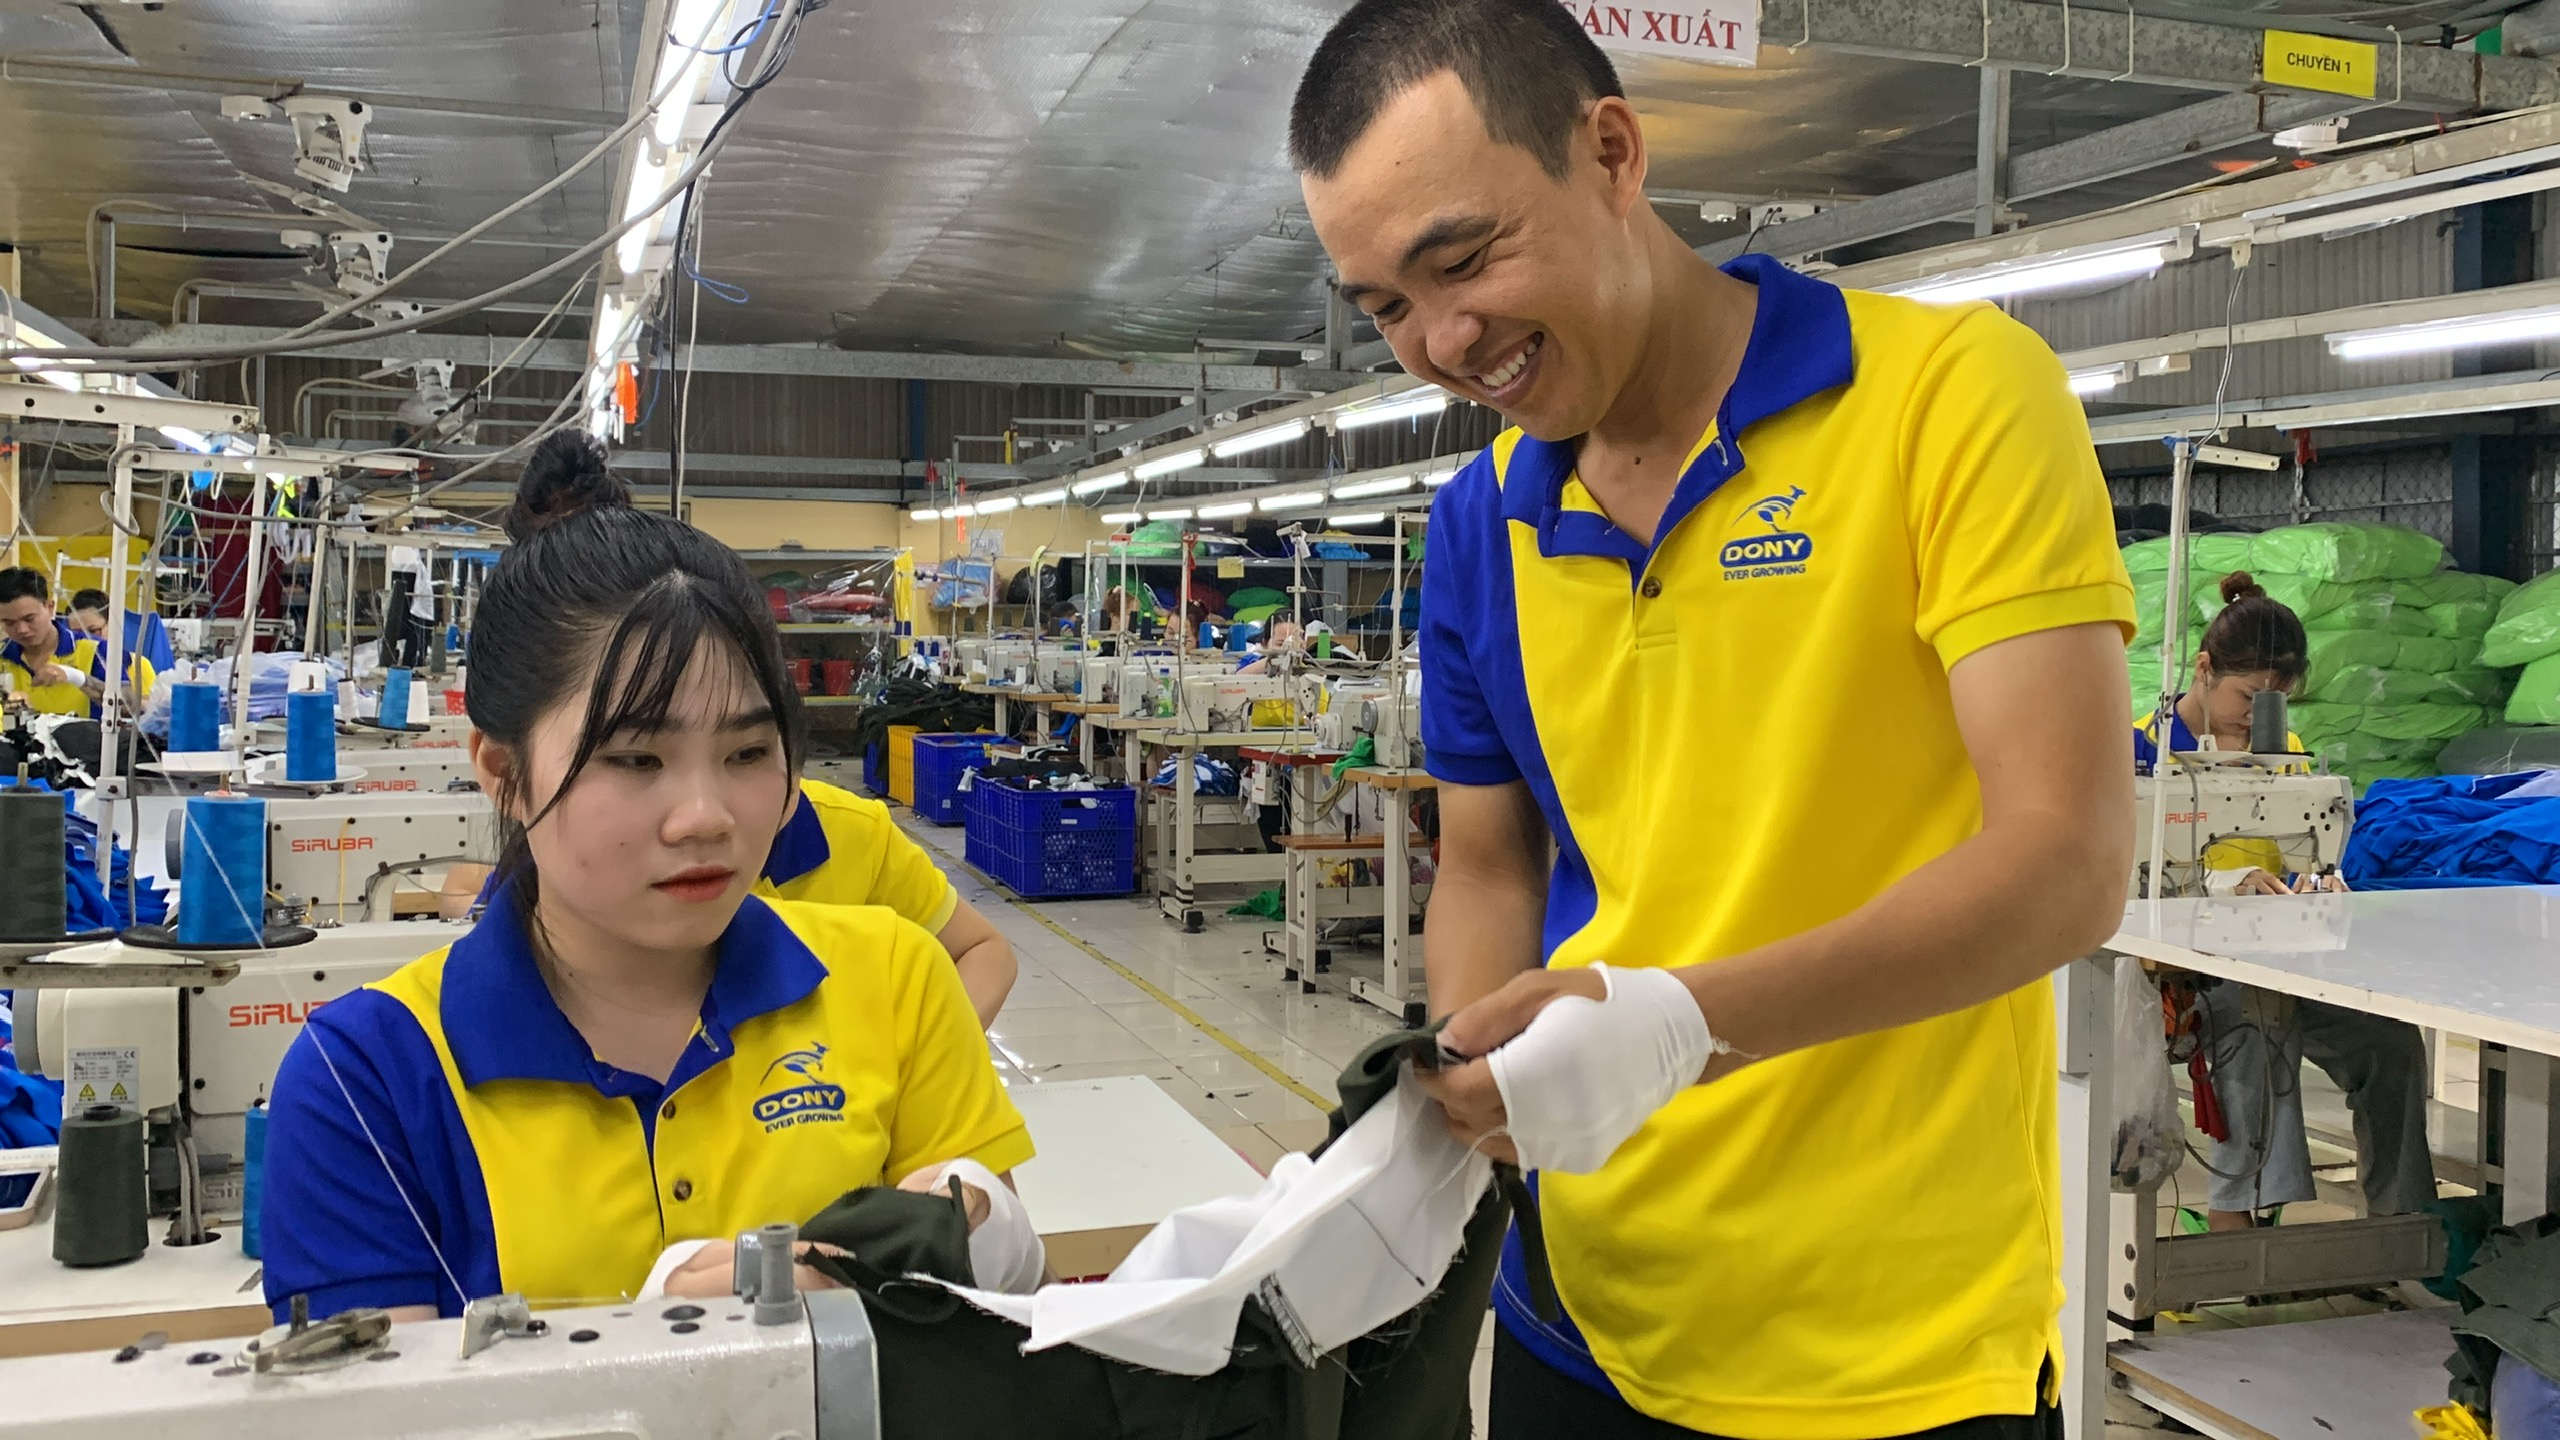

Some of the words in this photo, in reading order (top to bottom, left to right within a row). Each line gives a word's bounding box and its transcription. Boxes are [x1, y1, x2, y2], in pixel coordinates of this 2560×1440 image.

[1641, 9, 1742, 50] XUẤT
[2344, 61, 2351, 74] 1
[1724, 538, 1805, 562] DONY
[1724, 570, 1749, 580] EVER
[1751, 564, 1806, 578] GROWING
[758, 1089, 839, 1118] DONY
[764, 1117, 795, 1134] EVER
[797, 1112, 845, 1125] GROWING
